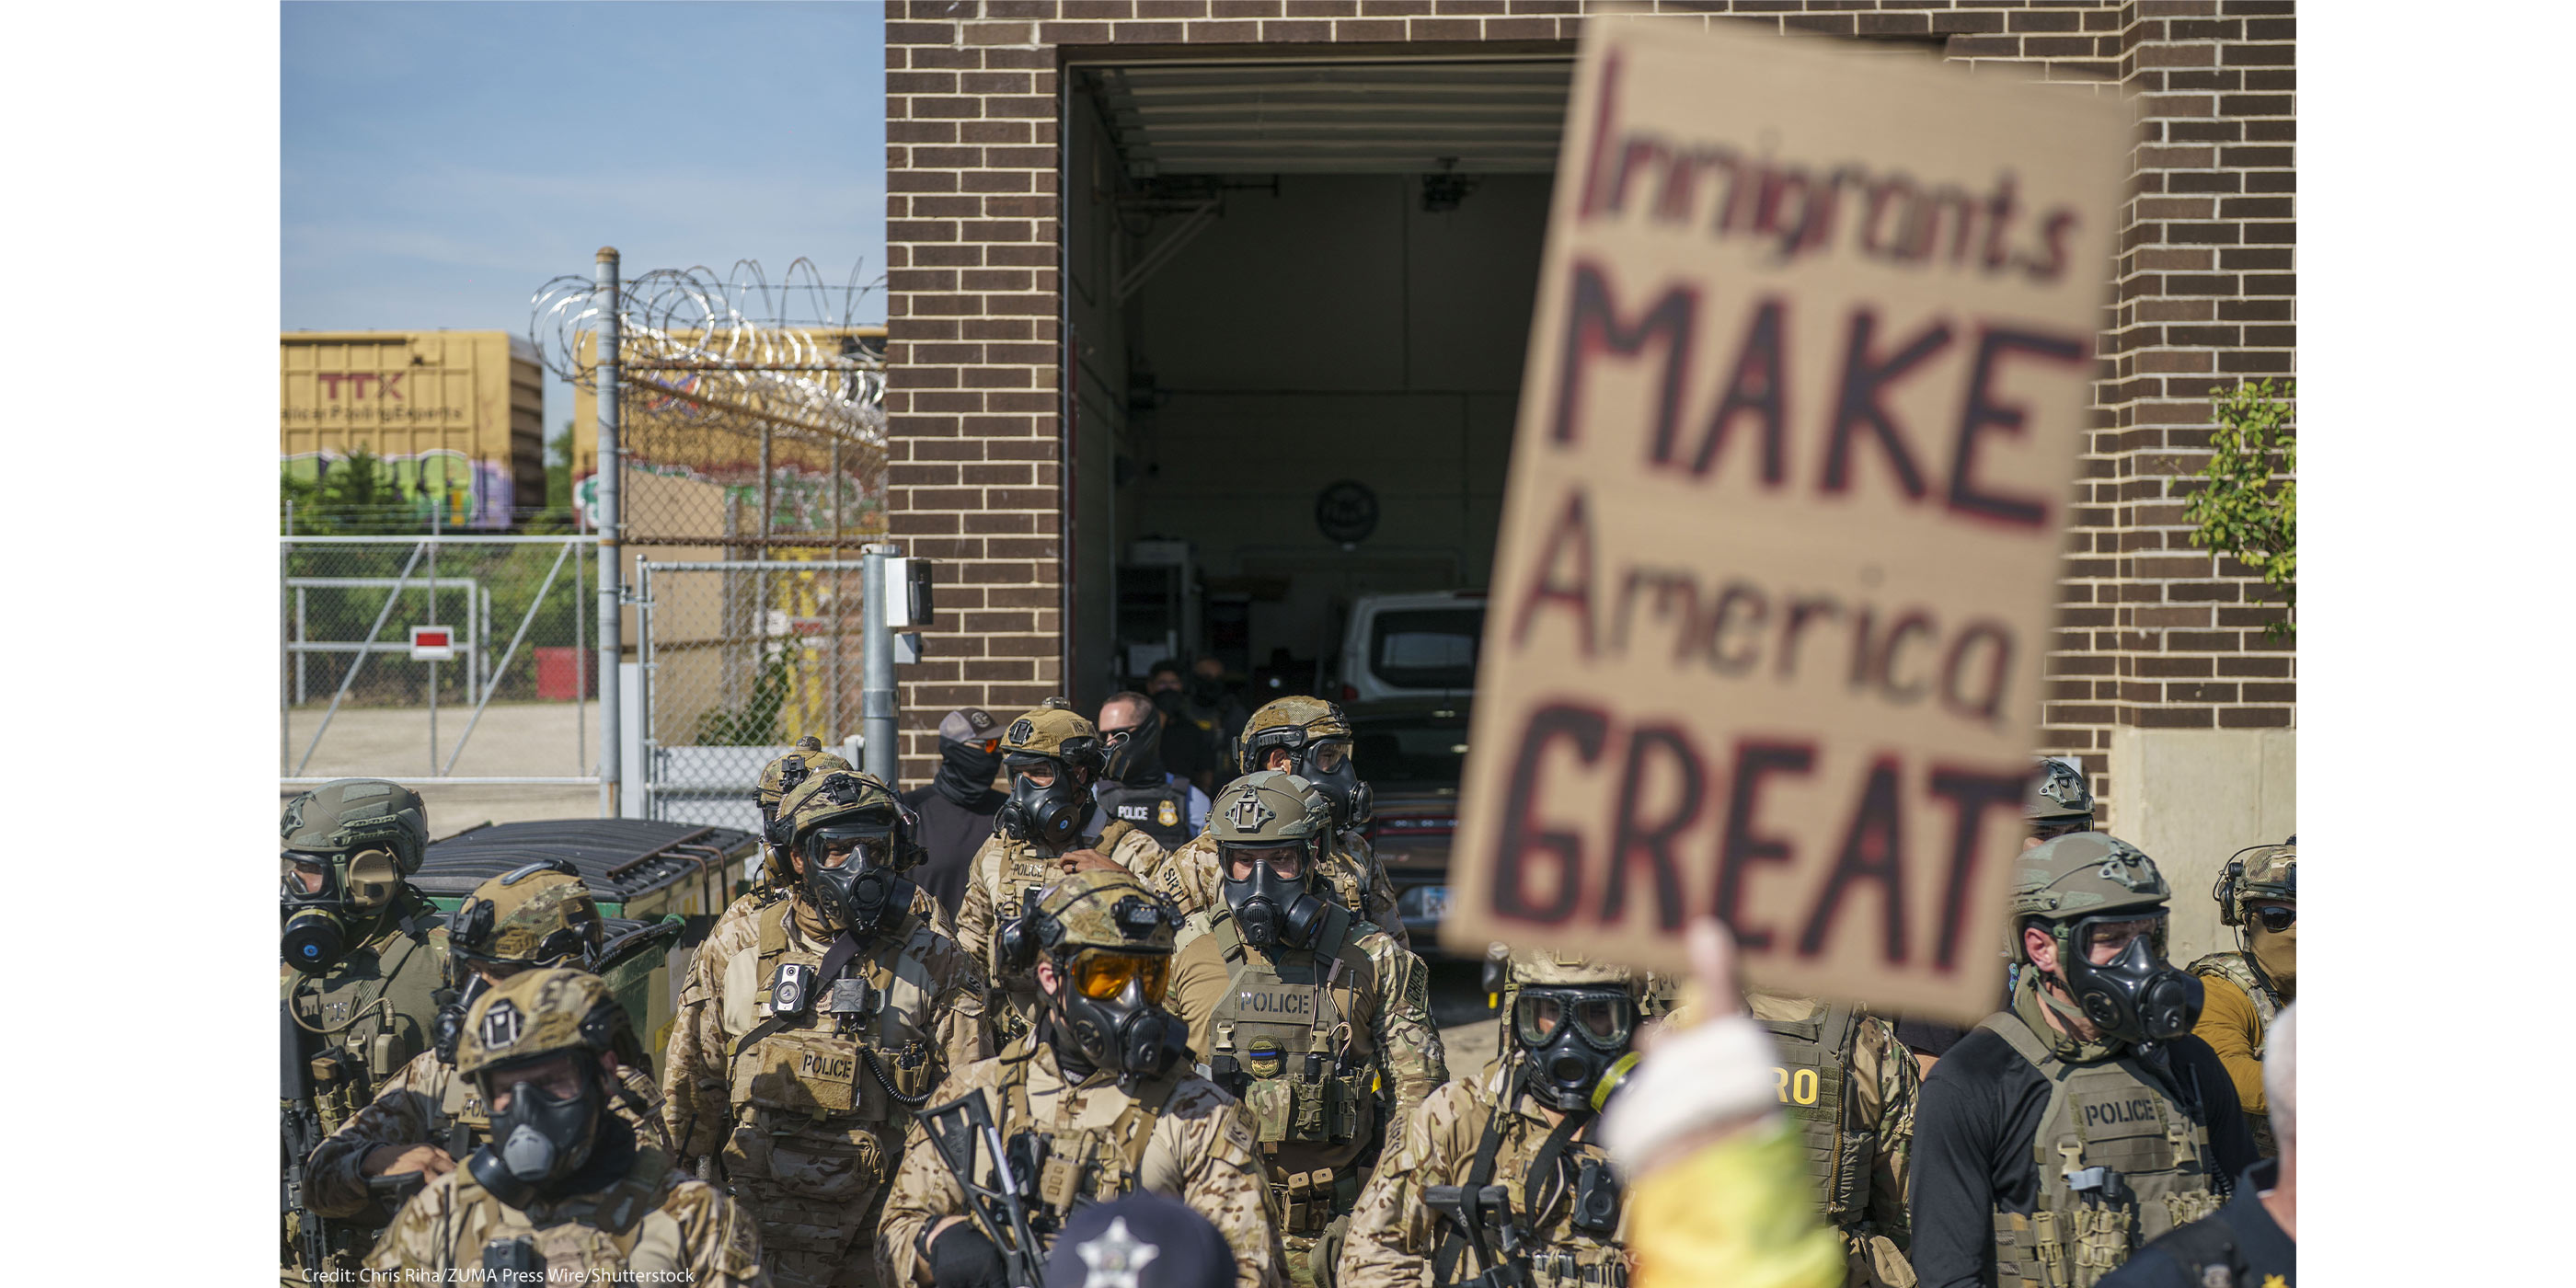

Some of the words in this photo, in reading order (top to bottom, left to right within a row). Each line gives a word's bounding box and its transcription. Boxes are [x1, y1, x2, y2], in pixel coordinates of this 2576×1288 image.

[317, 372, 404, 399] TTX
[1553, 258, 2089, 531] MAKE
[1509, 485, 2019, 729] America
[1118, 805, 1148, 820] POLICE
[1489, 700, 2039, 975] GREAT
[1013, 863, 1044, 878] POLICE
[1163, 868, 1185, 898] SRT
[1240, 992, 1309, 1014] POLICE
[802, 1053, 853, 1078] POLICE
[1770, 1066, 1819, 1105] RO
[462, 1098, 489, 1118] POL
[2084, 1099, 2156, 1127] POLICE
